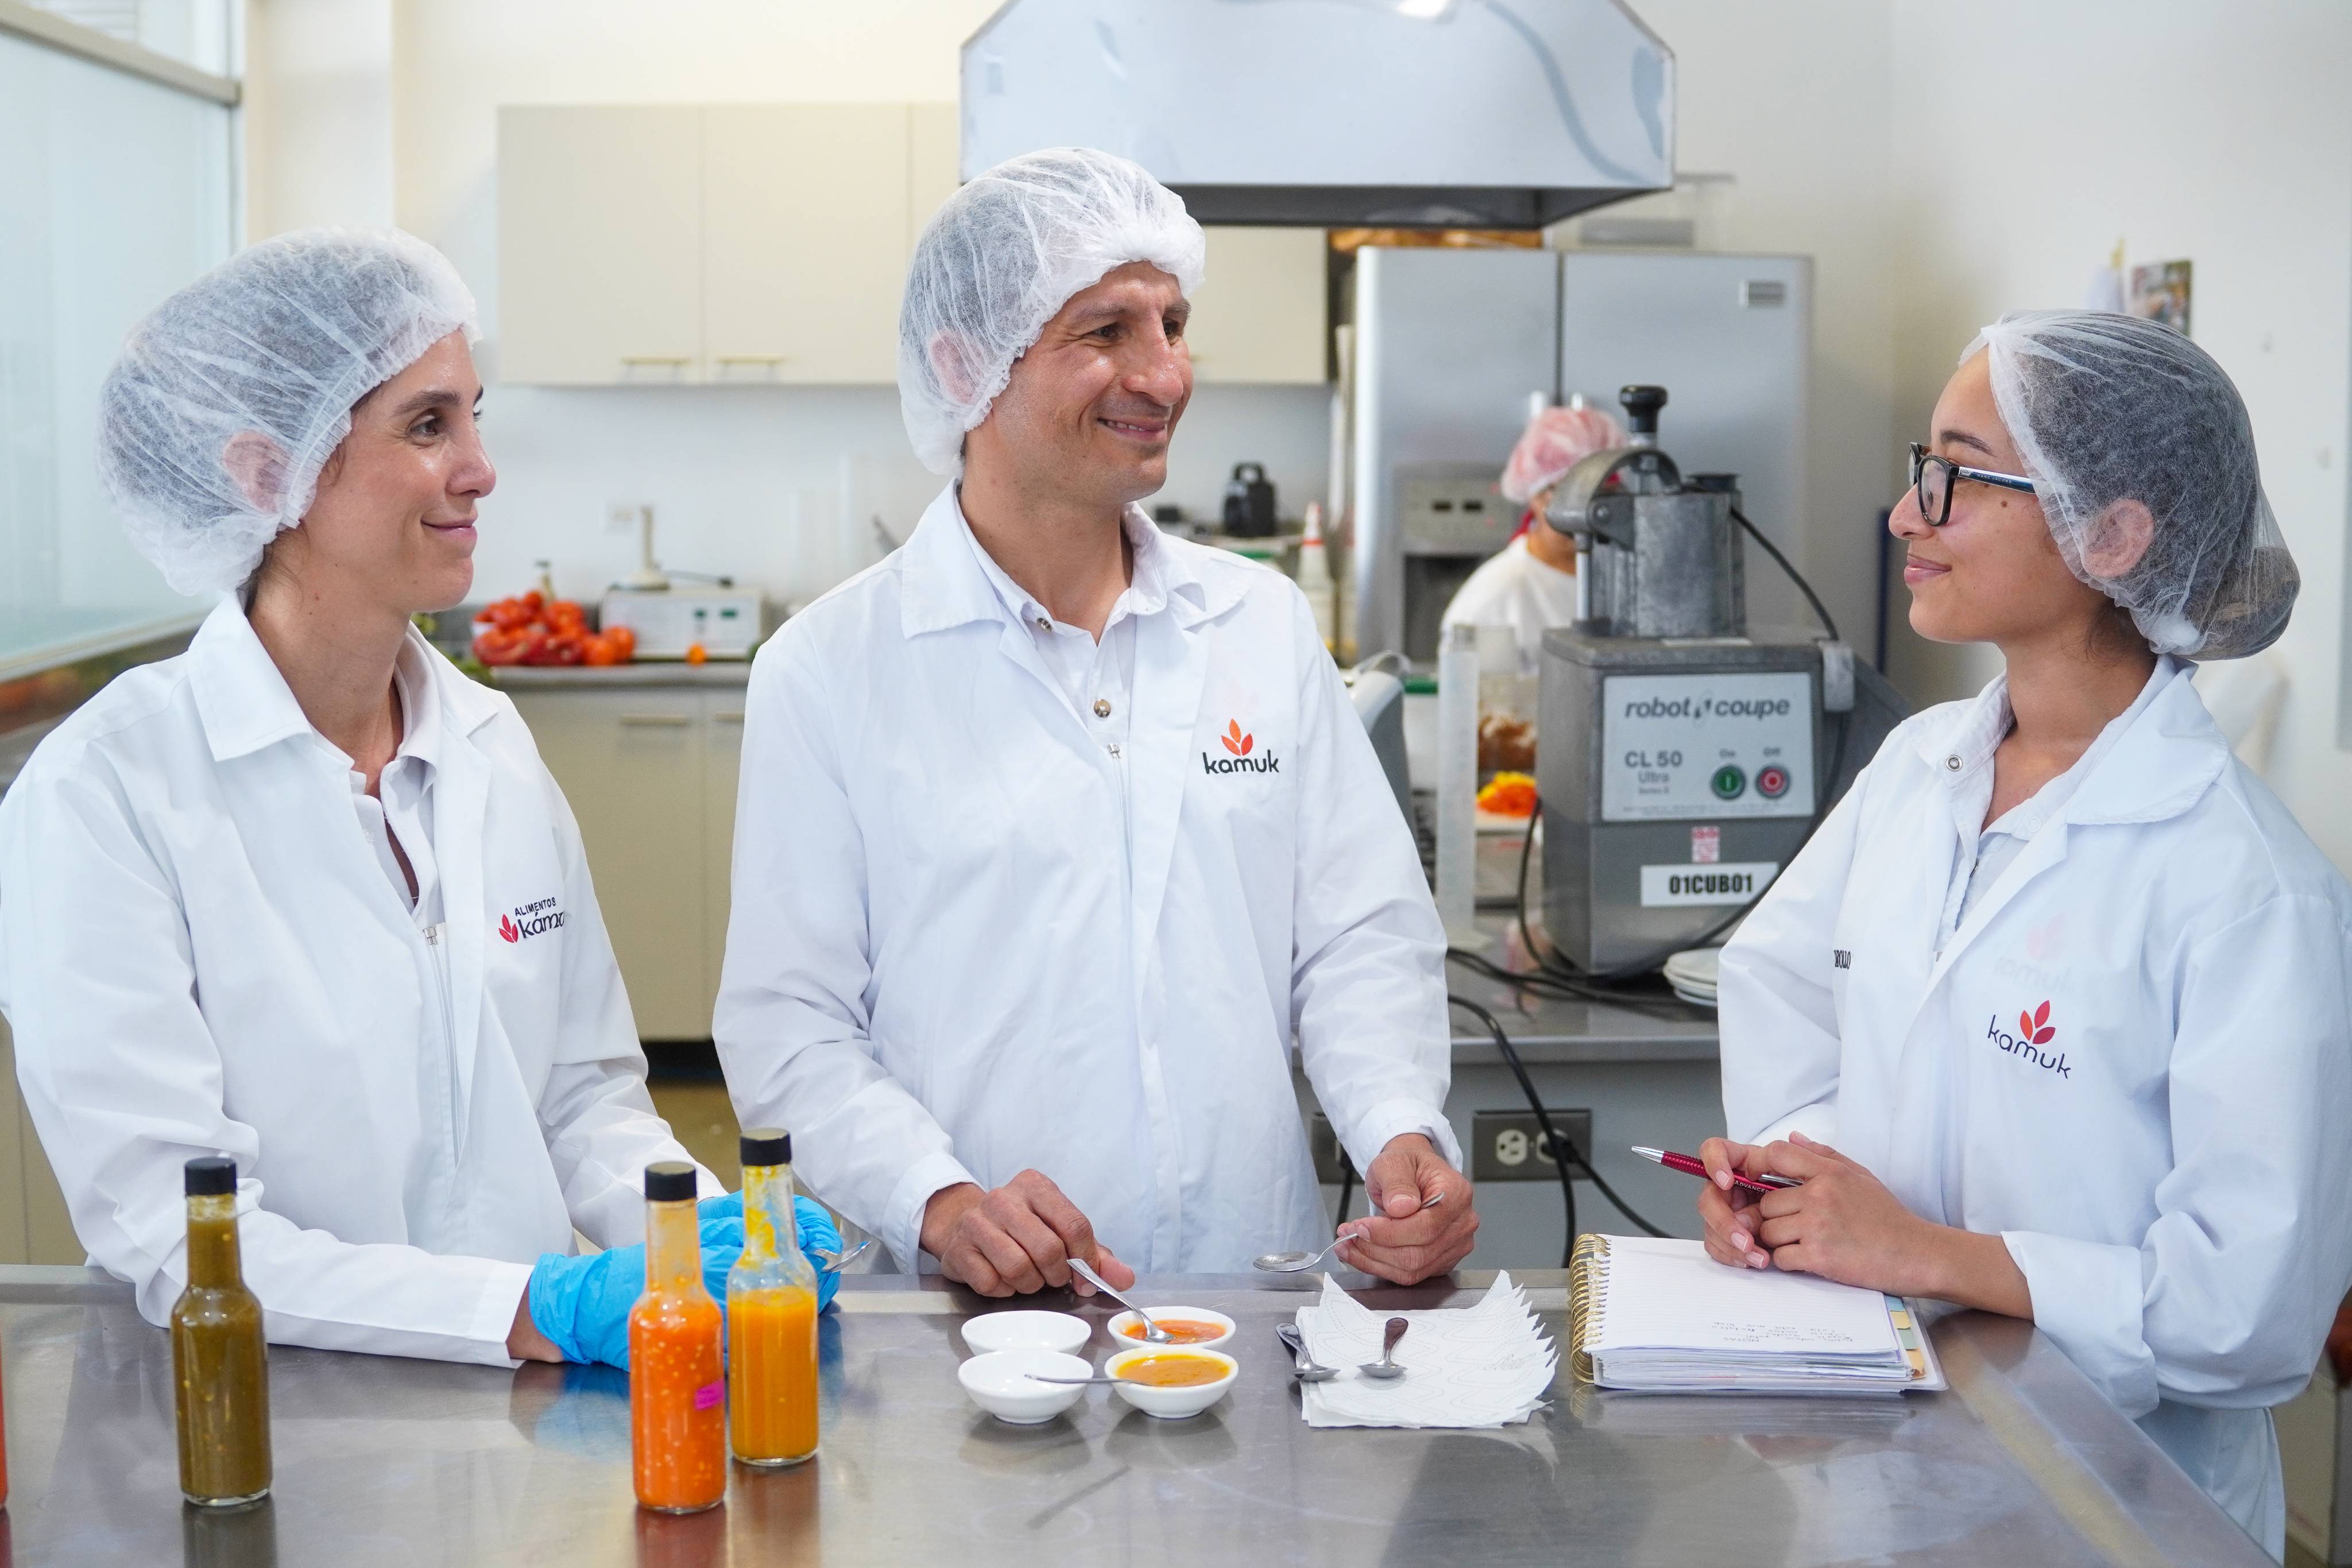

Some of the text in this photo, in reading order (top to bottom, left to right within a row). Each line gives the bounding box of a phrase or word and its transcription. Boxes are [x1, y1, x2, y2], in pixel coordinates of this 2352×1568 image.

[1625, 698, 1790, 720] robot coupe
[1202, 749, 1280, 775] kamuk
[1624, 750, 1683, 768] CL 50
[1638, 771, 1670, 784] Ultra
[1669, 874, 1753, 895] 01CUB01
[515, 897, 556, 916] ALIMENTOS
[1987, 1014, 2071, 1079] kamuk
